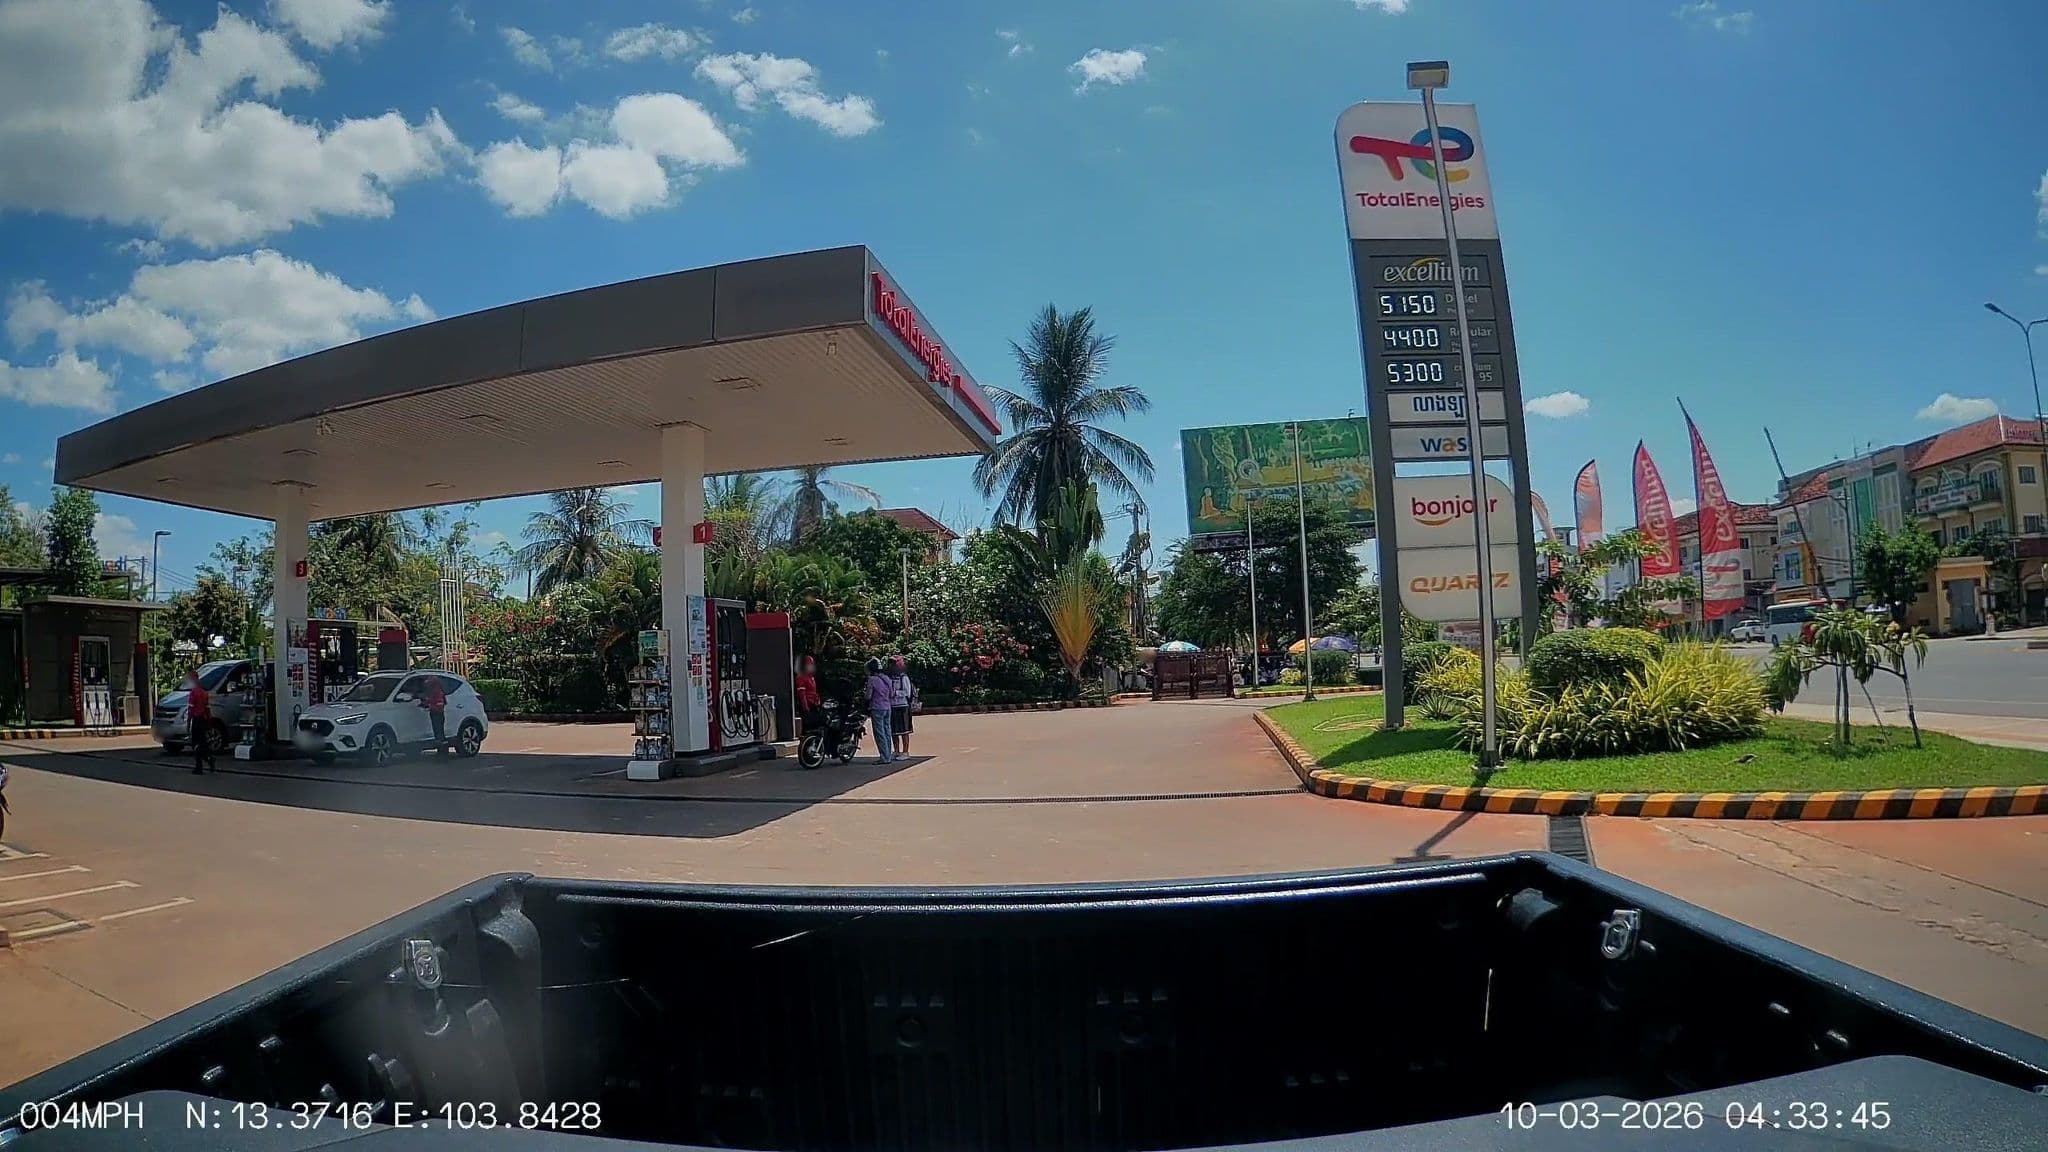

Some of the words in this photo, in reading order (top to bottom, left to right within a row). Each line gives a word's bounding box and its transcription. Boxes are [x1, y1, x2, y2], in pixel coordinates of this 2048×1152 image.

[1355, 192, 1485, 211] TotalEnegies
[1380, 295, 1436, 314] 5150
[1384, 328, 1439, 347] 4400
[1449, 327, 1492, 337] Rular
[1387, 362, 1443, 382] 5300
[1479, 371, 1493, 382] 95
[1420, 437, 1468, 453] was
[1411, 494, 1499, 519] bonjor
[1410, 572, 1510, 594] QUARZ
